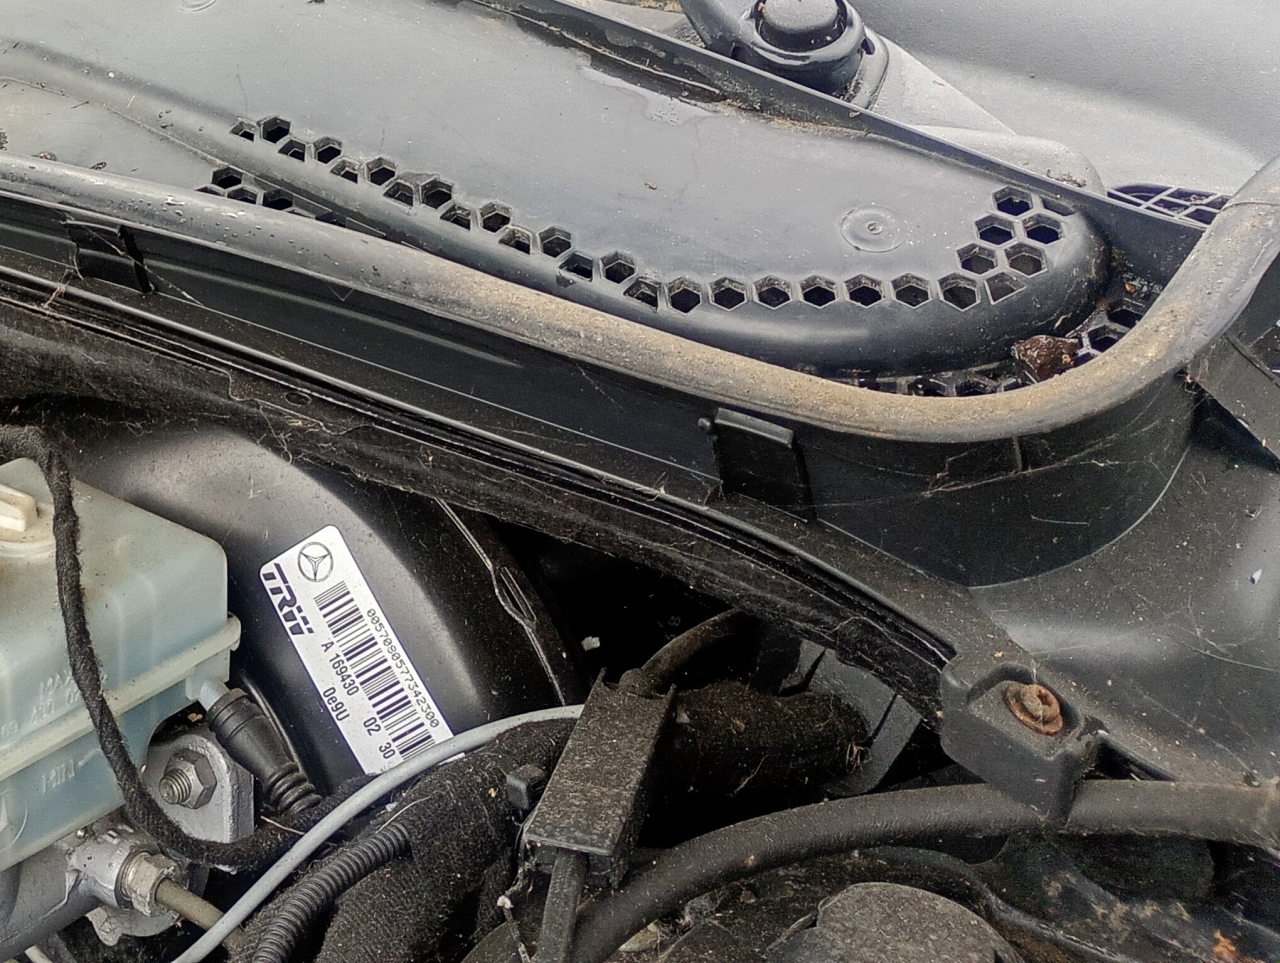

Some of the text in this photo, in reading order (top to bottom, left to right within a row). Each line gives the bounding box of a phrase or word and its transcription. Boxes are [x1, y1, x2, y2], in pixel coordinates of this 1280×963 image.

[262, 563, 315, 635] TRW
[321, 641, 335, 653] A
[329, 653, 359, 696] 169430
[363, 717, 381, 736] 02
[379, 742, 396, 759] 30
[366, 608, 440, 728] 0057080577342300
